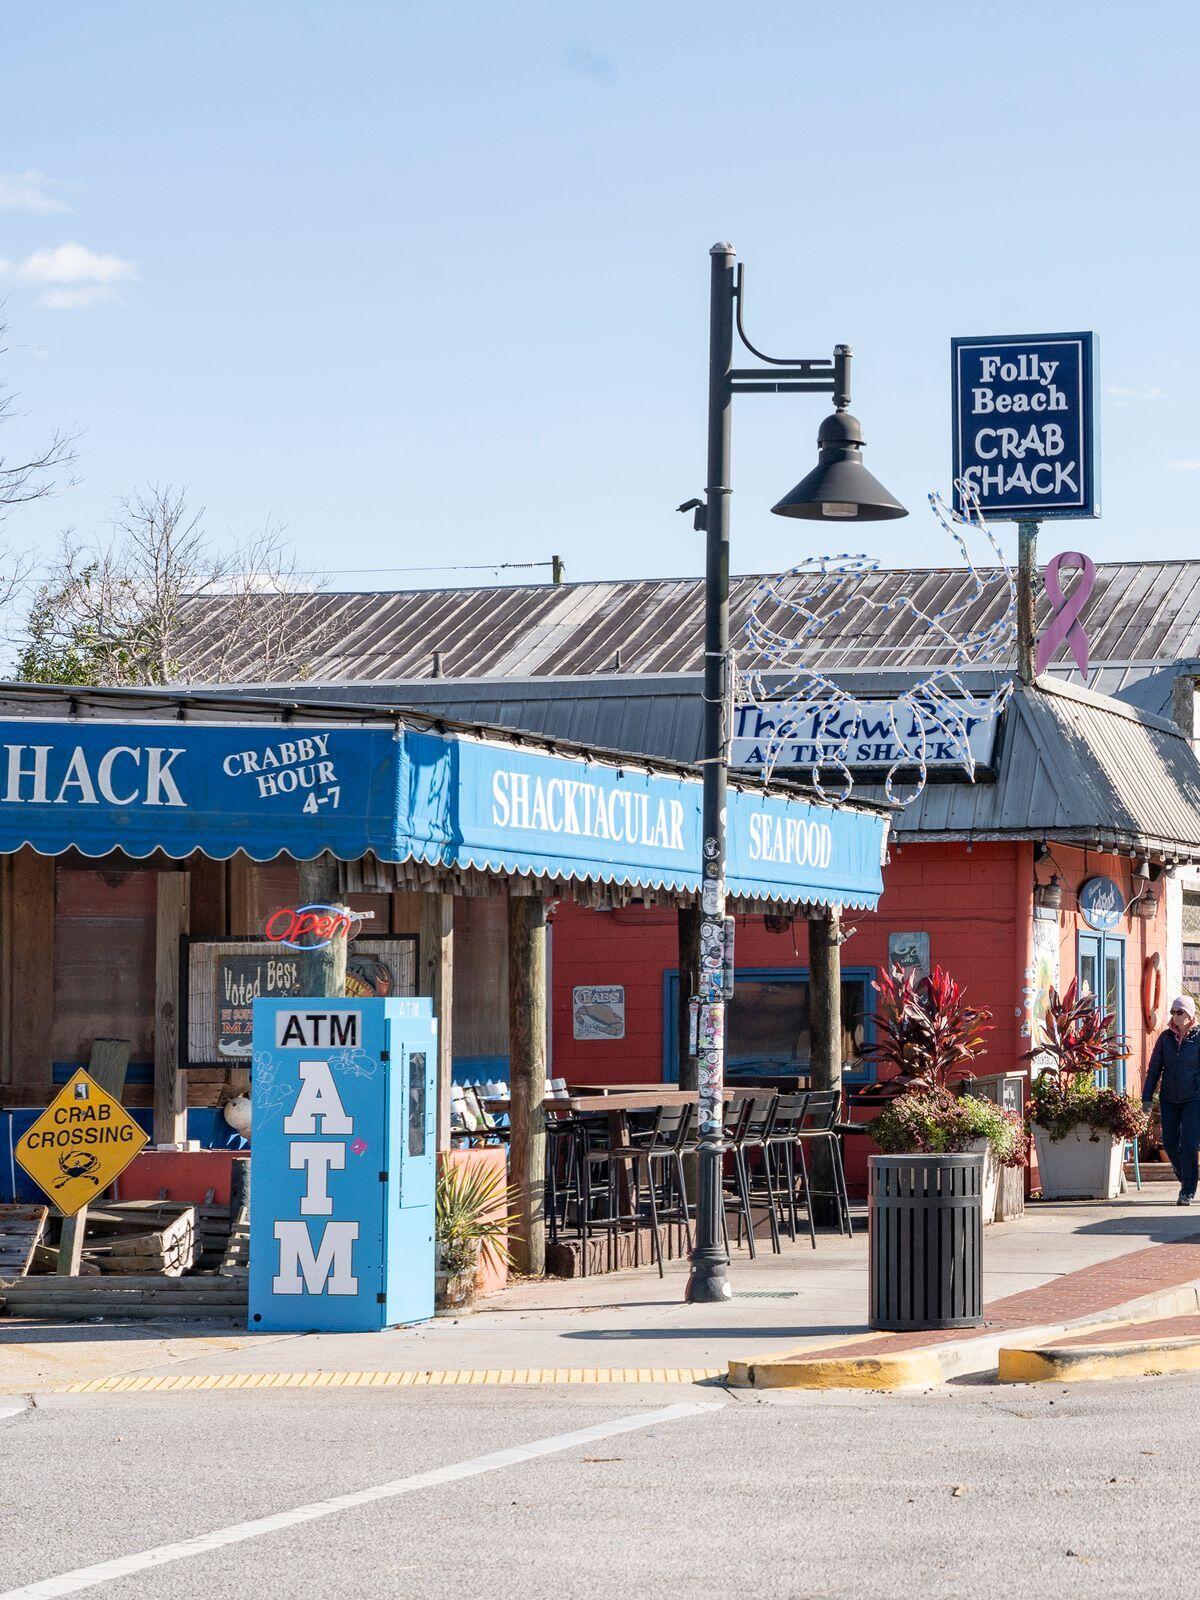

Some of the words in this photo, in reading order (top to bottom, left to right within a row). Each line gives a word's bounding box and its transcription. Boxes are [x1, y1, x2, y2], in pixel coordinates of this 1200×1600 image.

[980, 354, 1059, 386] Folly
[972, 385, 1068, 414] Beach
[975, 423, 1065, 459] CRAB
[964, 461, 1078, 496] SHACK
[735, 705, 798, 738] The
[806, 704, 897, 739] Raw
[907, 702, 982, 737] Bar
[222, 733, 330, 777] CRABBY
[791, 744, 848, 762] THE
[856, 743, 957, 761] SHACK
[1, 744, 187, 807] HACK
[257, 761, 338, 799] HOUR
[302, 786, 341, 815] 4-7
[492, 769, 684, 850] SHACKTACULAR
[749, 812, 832, 869] SEAFOOD
[266, 909, 350, 941] Open
[224, 967, 260, 1006] Voted
[267, 961, 297, 991] Best
[281, 1014, 357, 1046] ATM
[54, 1103, 111, 1125] CRAB
[27, 1124, 133, 1149] CROSSING
[272, 1060, 360, 1295] ATM
